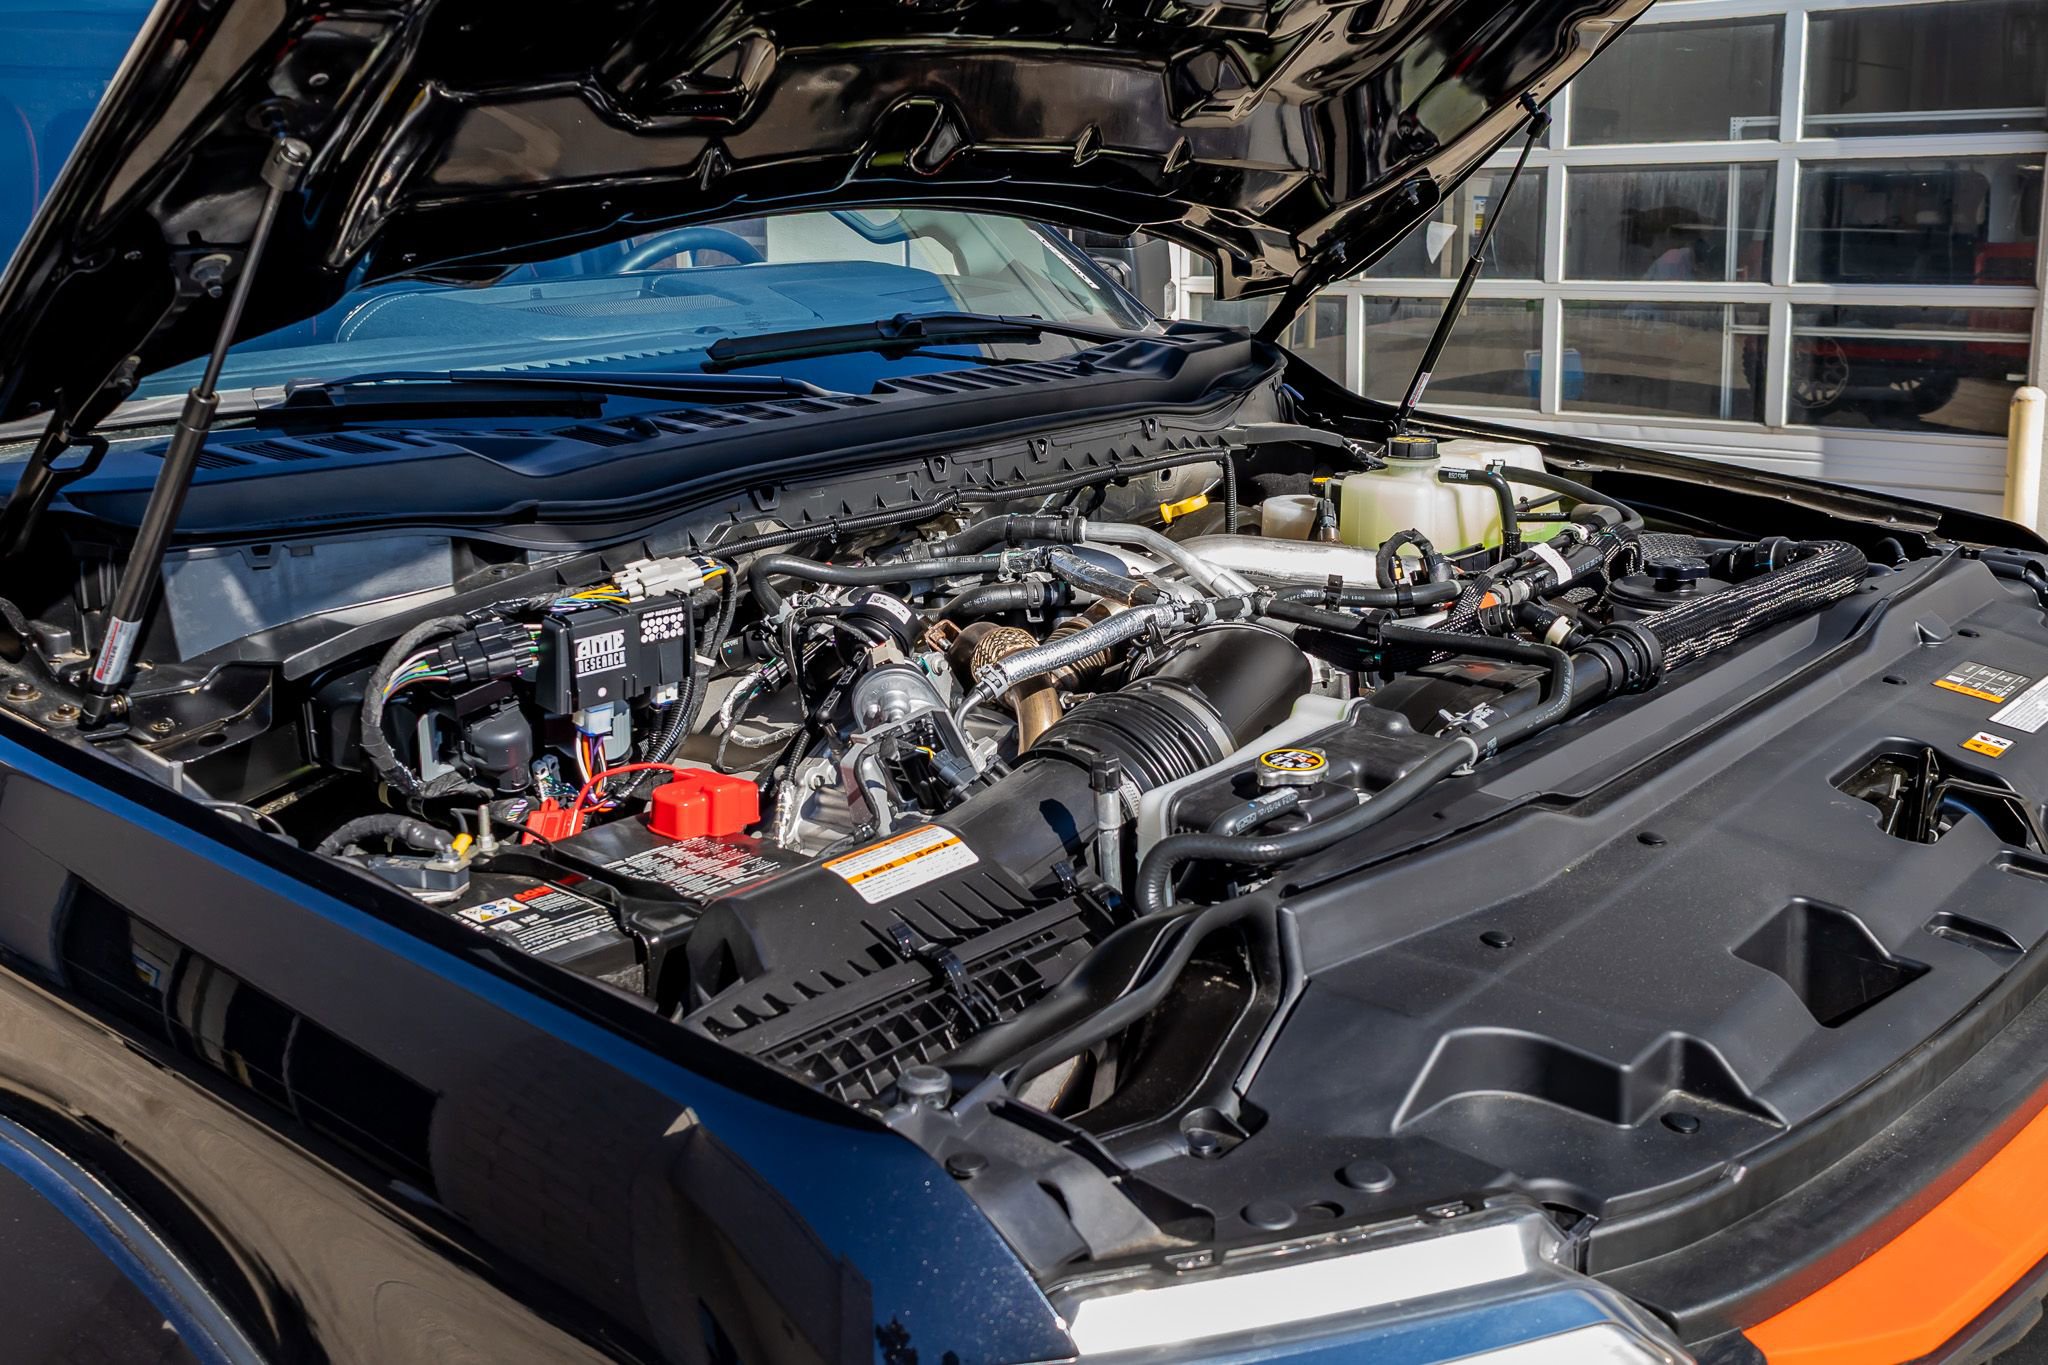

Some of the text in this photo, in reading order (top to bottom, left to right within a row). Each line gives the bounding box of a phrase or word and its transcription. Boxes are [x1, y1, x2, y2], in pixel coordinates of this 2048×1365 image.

[642, 606, 683, 620] AMP RESEARCH
[574, 629, 626, 661] AMP
[578, 651, 626, 674] RESEARCH
